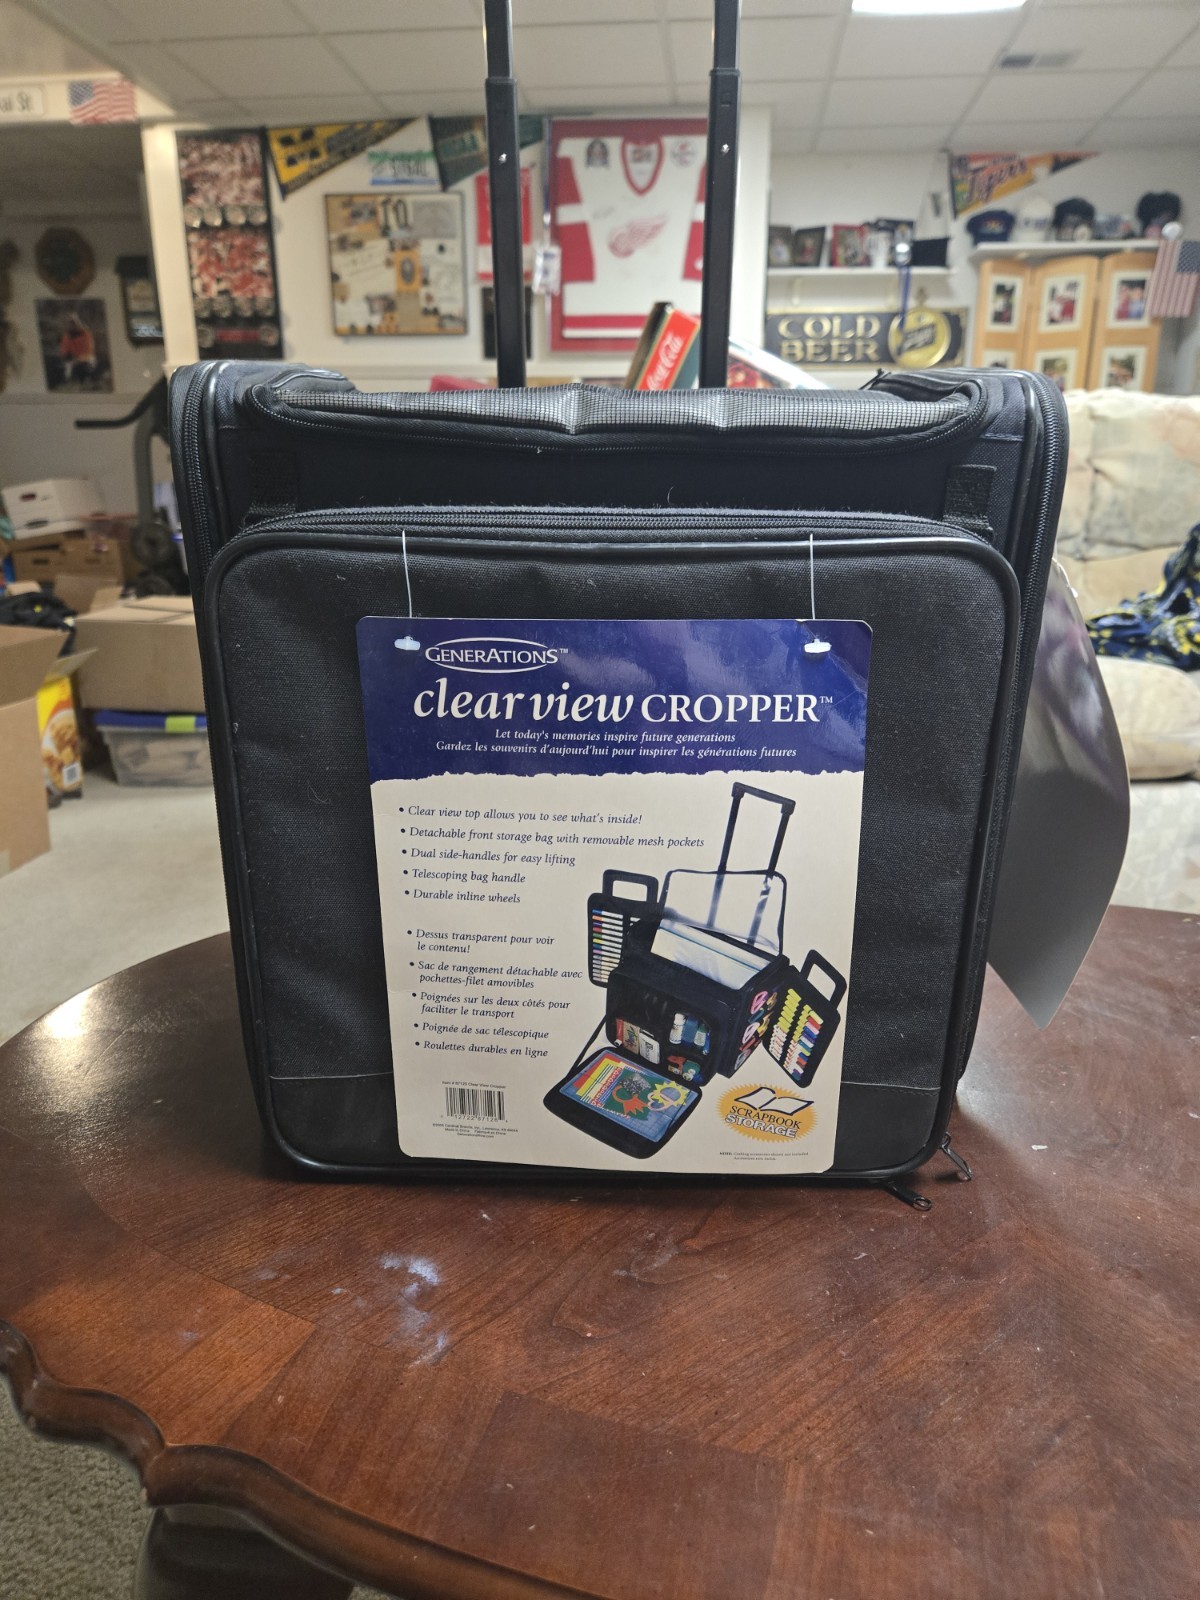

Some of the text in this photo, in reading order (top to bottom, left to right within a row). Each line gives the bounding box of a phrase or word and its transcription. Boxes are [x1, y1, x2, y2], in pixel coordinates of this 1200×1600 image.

[778, 315, 880, 339] COLD
[780, 339, 880, 362] BEER
[414, 678, 525, 720] clear
[530, 682, 634, 722] view
[496, 729, 735, 744] Let today's memories inspire future generations
[437, 741, 796, 759] Gardez les souvenirs d'aujourd'hui pour inspirer les générations futures
[408, 806, 435, 816] Clear
[439, 808, 461, 817] view
[465, 809, 480, 820] top
[484, 809, 515, 819] allows
[518, 812, 536, 822] you
[540, 812, 549, 821] to
[571, 812, 604, 823] what's
[608, 814, 642, 824] inside!
[410, 827, 704, 848] Detachable front storage bag with removable mesh pockets
[411, 848, 575, 866] Dual side-handles for easy lifting
[412, 869, 525, 883] Telescoping bag handle
[413, 889, 520, 903] Durable inline wheels
[416, 929, 554, 945] Dessus transparent pour voir
[418, 942, 470, 953] le contenu!
[418, 961, 435, 970] Sac
[438, 962, 448, 970] de
[452, 964, 503, 974] rangement
[506, 966, 558, 977] détachable
[420, 974, 534, 988] pochettes-filet amovibles
[421, 992, 570, 1010] Poignées sur les deux côtés pour
[421, 1004, 514, 1019] faciliter le transport
[423, 1022, 458, 1034] Poignée
[462, 1025, 472, 1034] de
[493, 1028, 549, 1040] télescopique
[424, 1041, 465, 1051] Roulettes
[469, 1043, 507, 1054] durables
[525, 1047, 548, 1058] ligne
[725, 1113, 798, 1138] STORAGE
[729, 1106, 802, 1129] SCRAPBOOK
